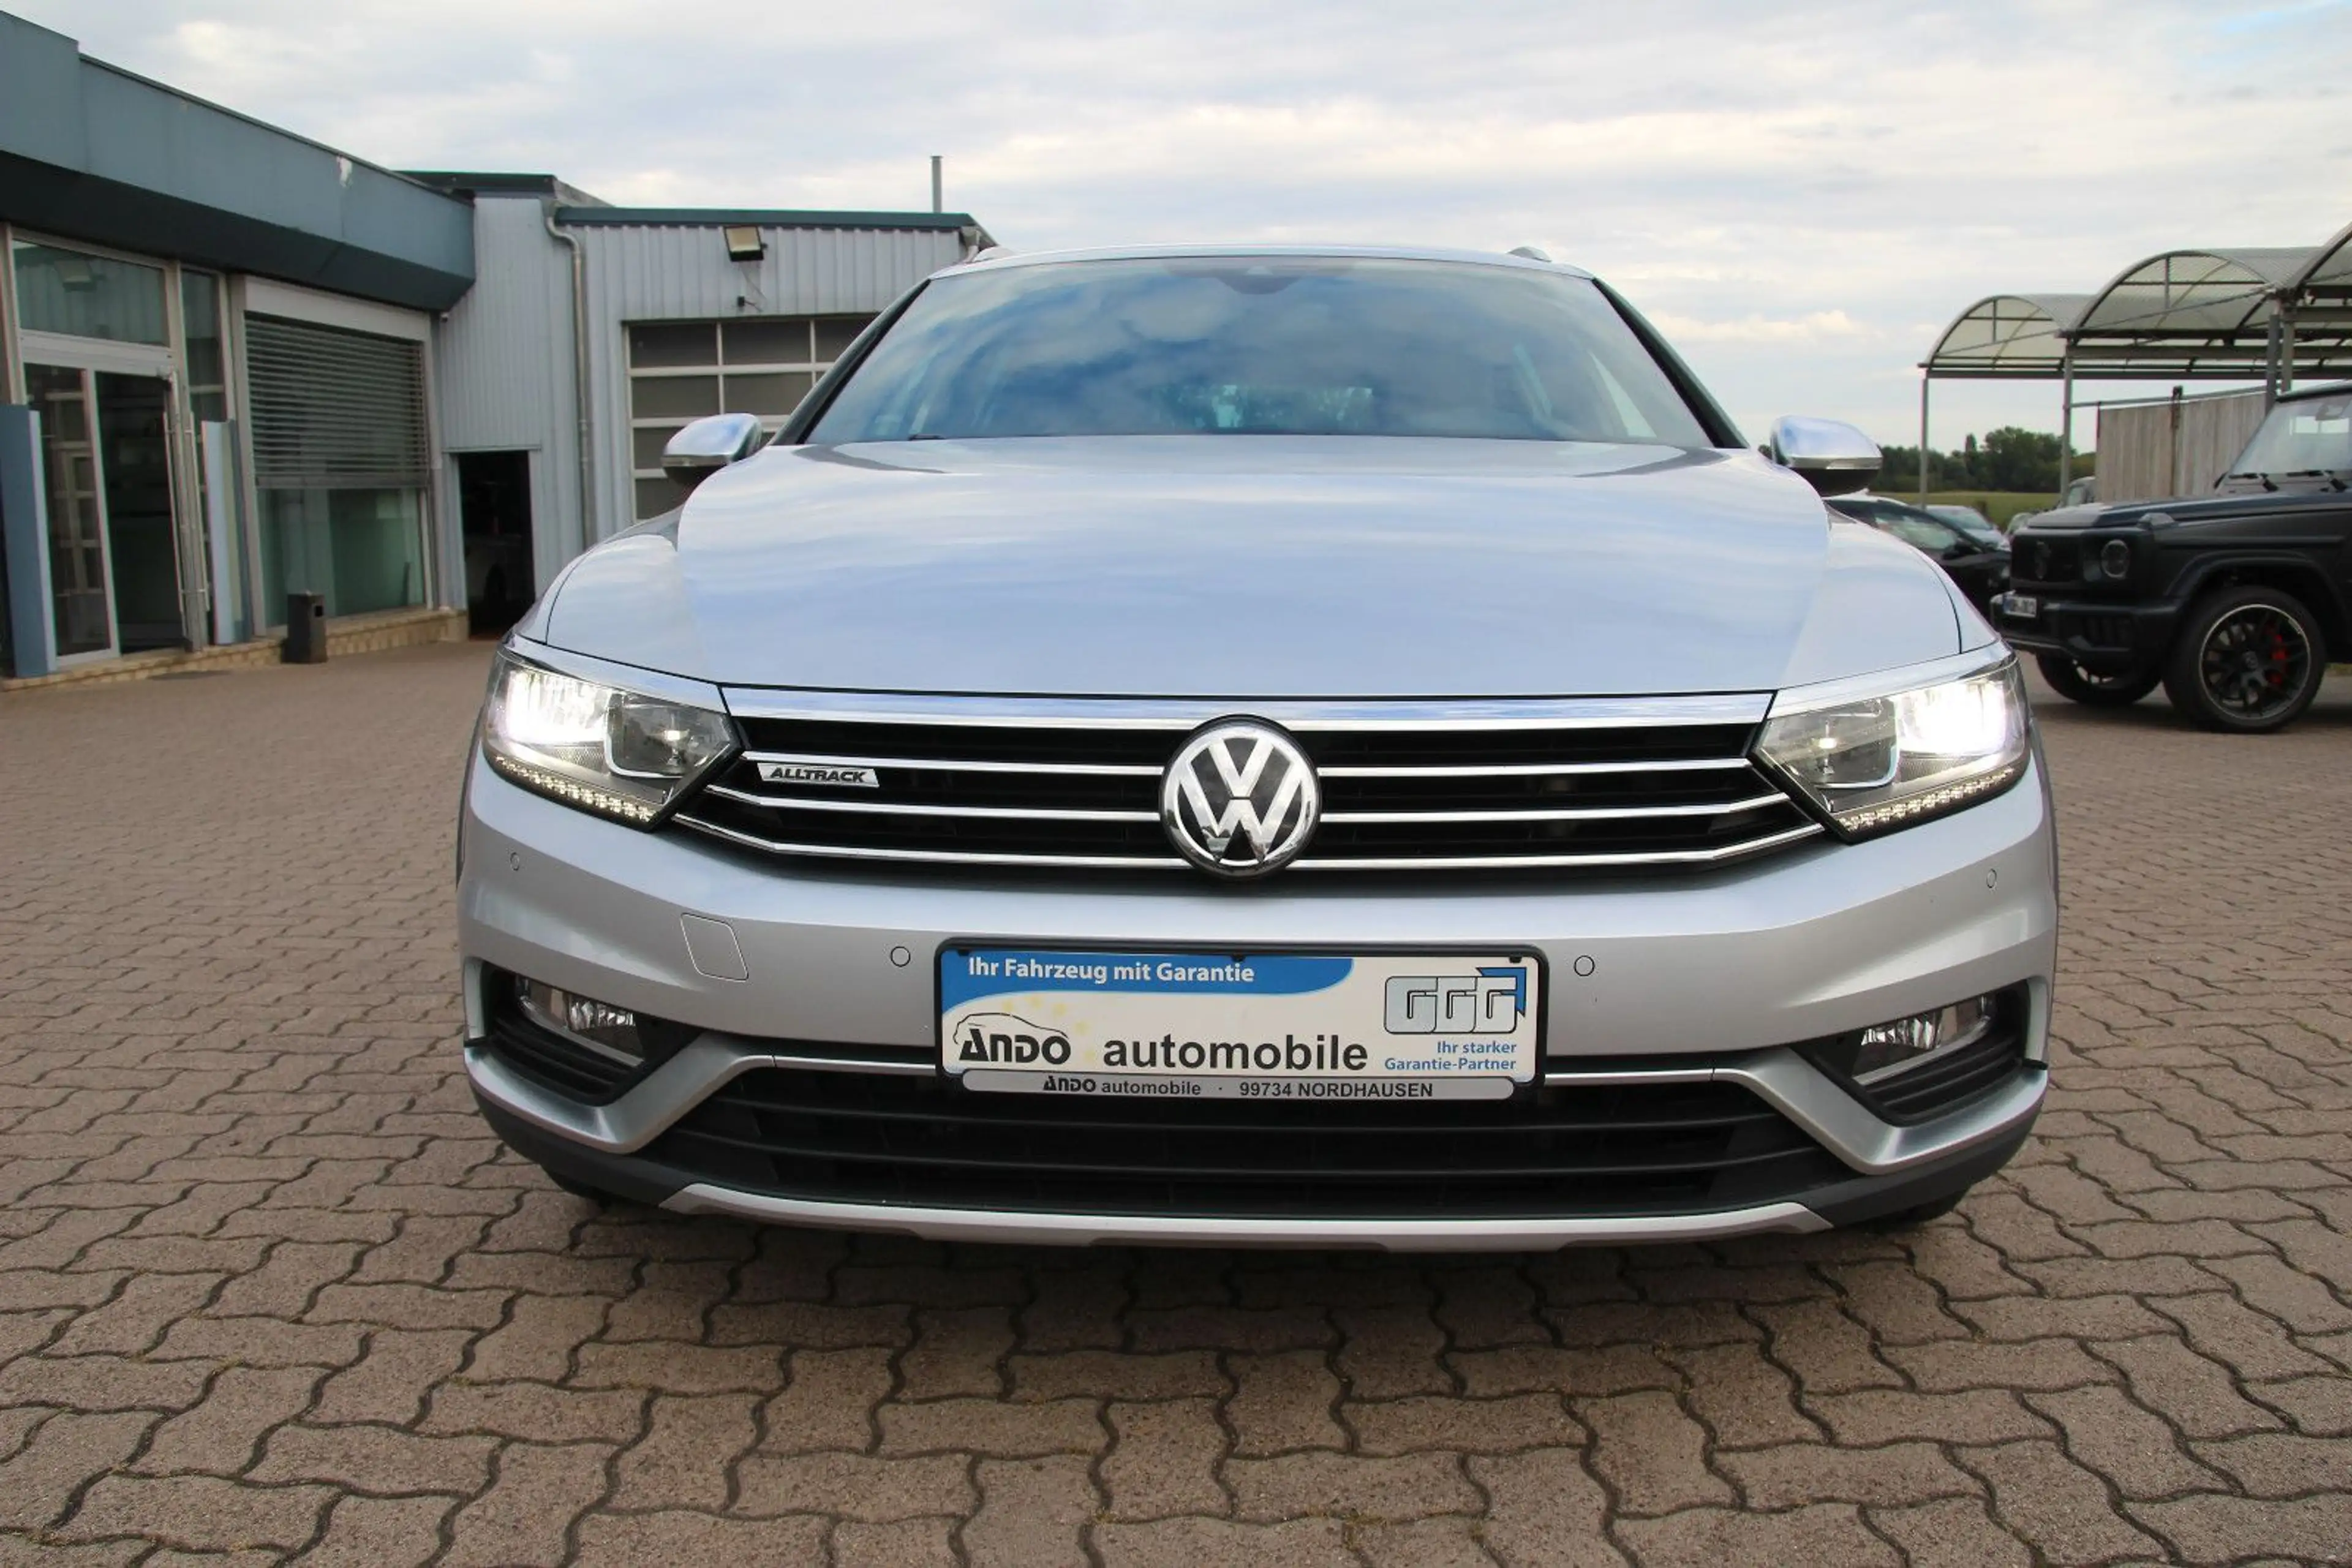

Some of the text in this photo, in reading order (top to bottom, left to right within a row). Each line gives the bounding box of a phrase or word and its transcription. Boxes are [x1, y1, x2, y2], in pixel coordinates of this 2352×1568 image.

[769, 767, 867, 783] ALLTRACK
[969, 957, 1254, 984] Ihr Fahrzeug mit Garantie
[1103, 1033, 1368, 1071] automobile
[1437, 1041, 1517, 1054] Ihr starker
[1384, 1057, 1517, 1071] Garantie-Partner
[1102, 1079, 1201, 1095] automobile
[1240, 1082, 1292, 1097] 99734
[1298, 1082, 1433, 1098] NORDHAUSEN
